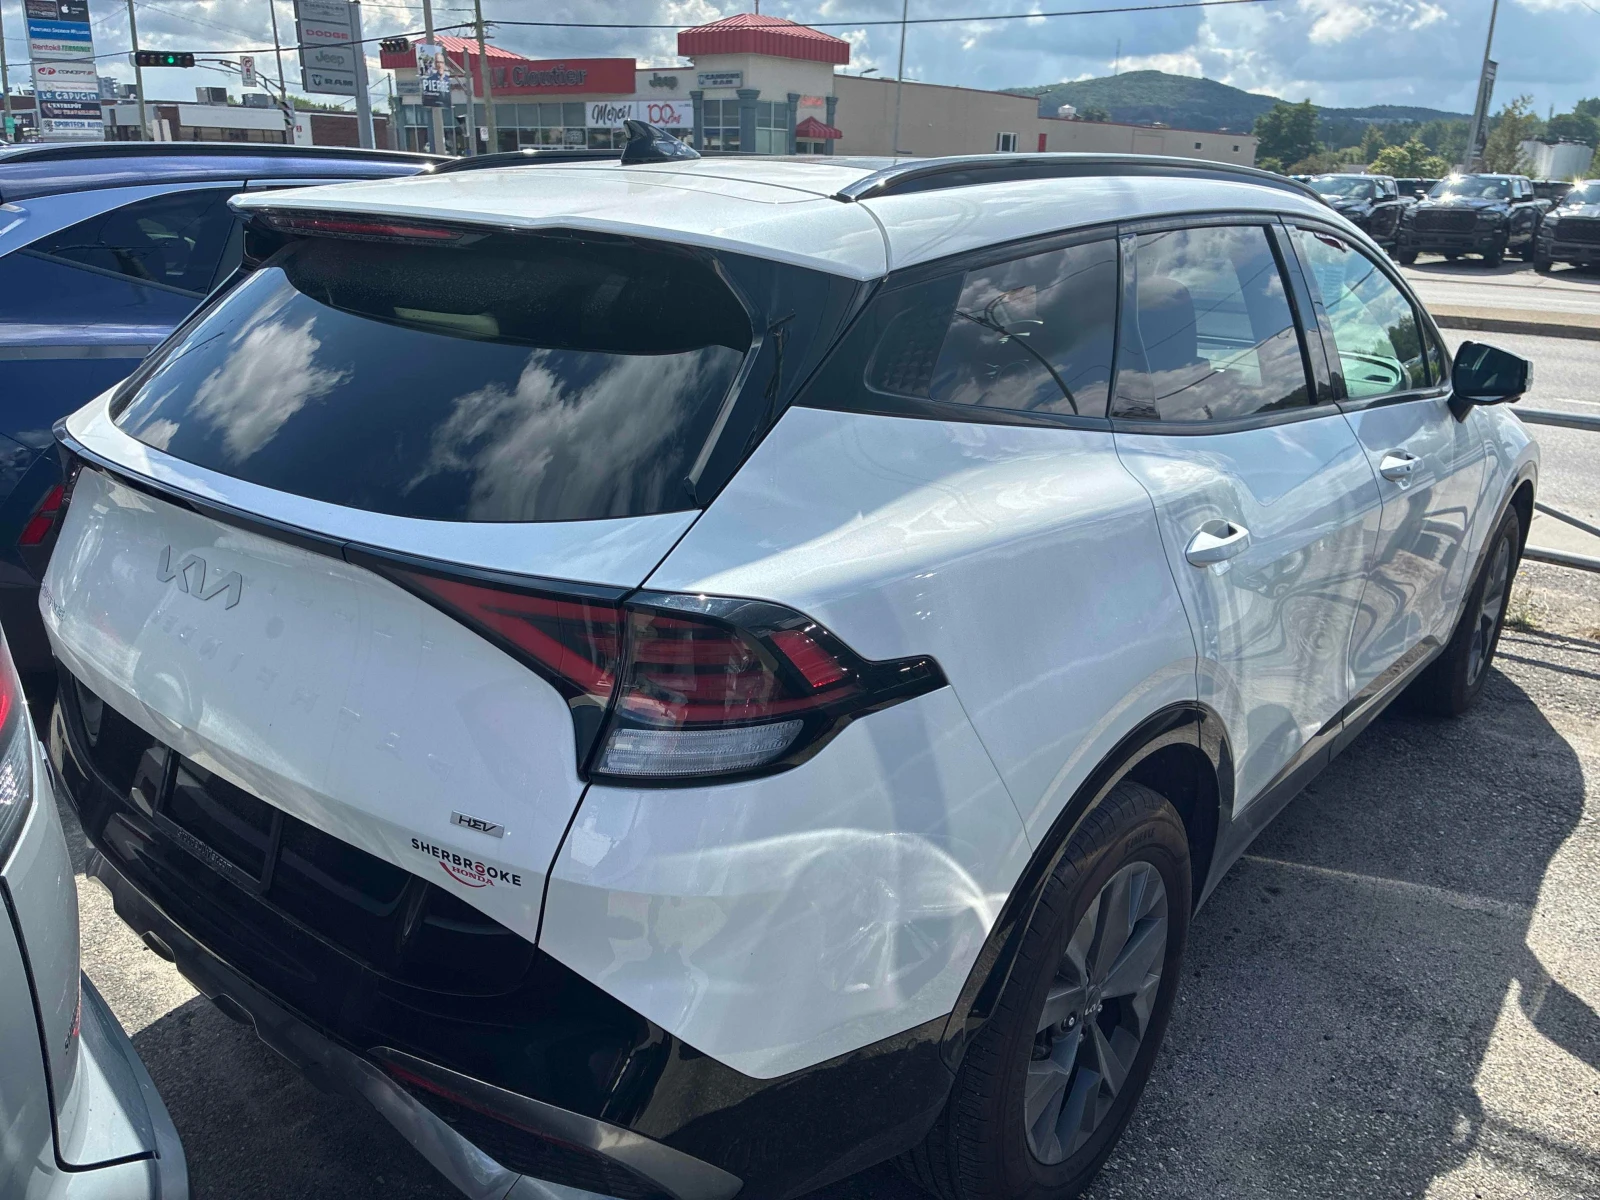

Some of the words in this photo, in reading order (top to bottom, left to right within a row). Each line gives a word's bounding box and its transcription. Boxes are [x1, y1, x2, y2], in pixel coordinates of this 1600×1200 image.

[305, 28, 349, 40] DODGE
[315, 50, 345, 67] Jeep
[325, 78, 354, 87] RAM
[512, 64, 587, 87] Cloutier
[649, 72, 678, 91] Jeep
[423, 79, 450, 93] PIERRE
[591, 103, 632, 125] Merci!
[156, 544, 243, 611] KIA
[458, 814, 498, 833] HEV
[411, 837, 522, 887] SHERBROOKE
[451, 865, 496, 887] HONDA
